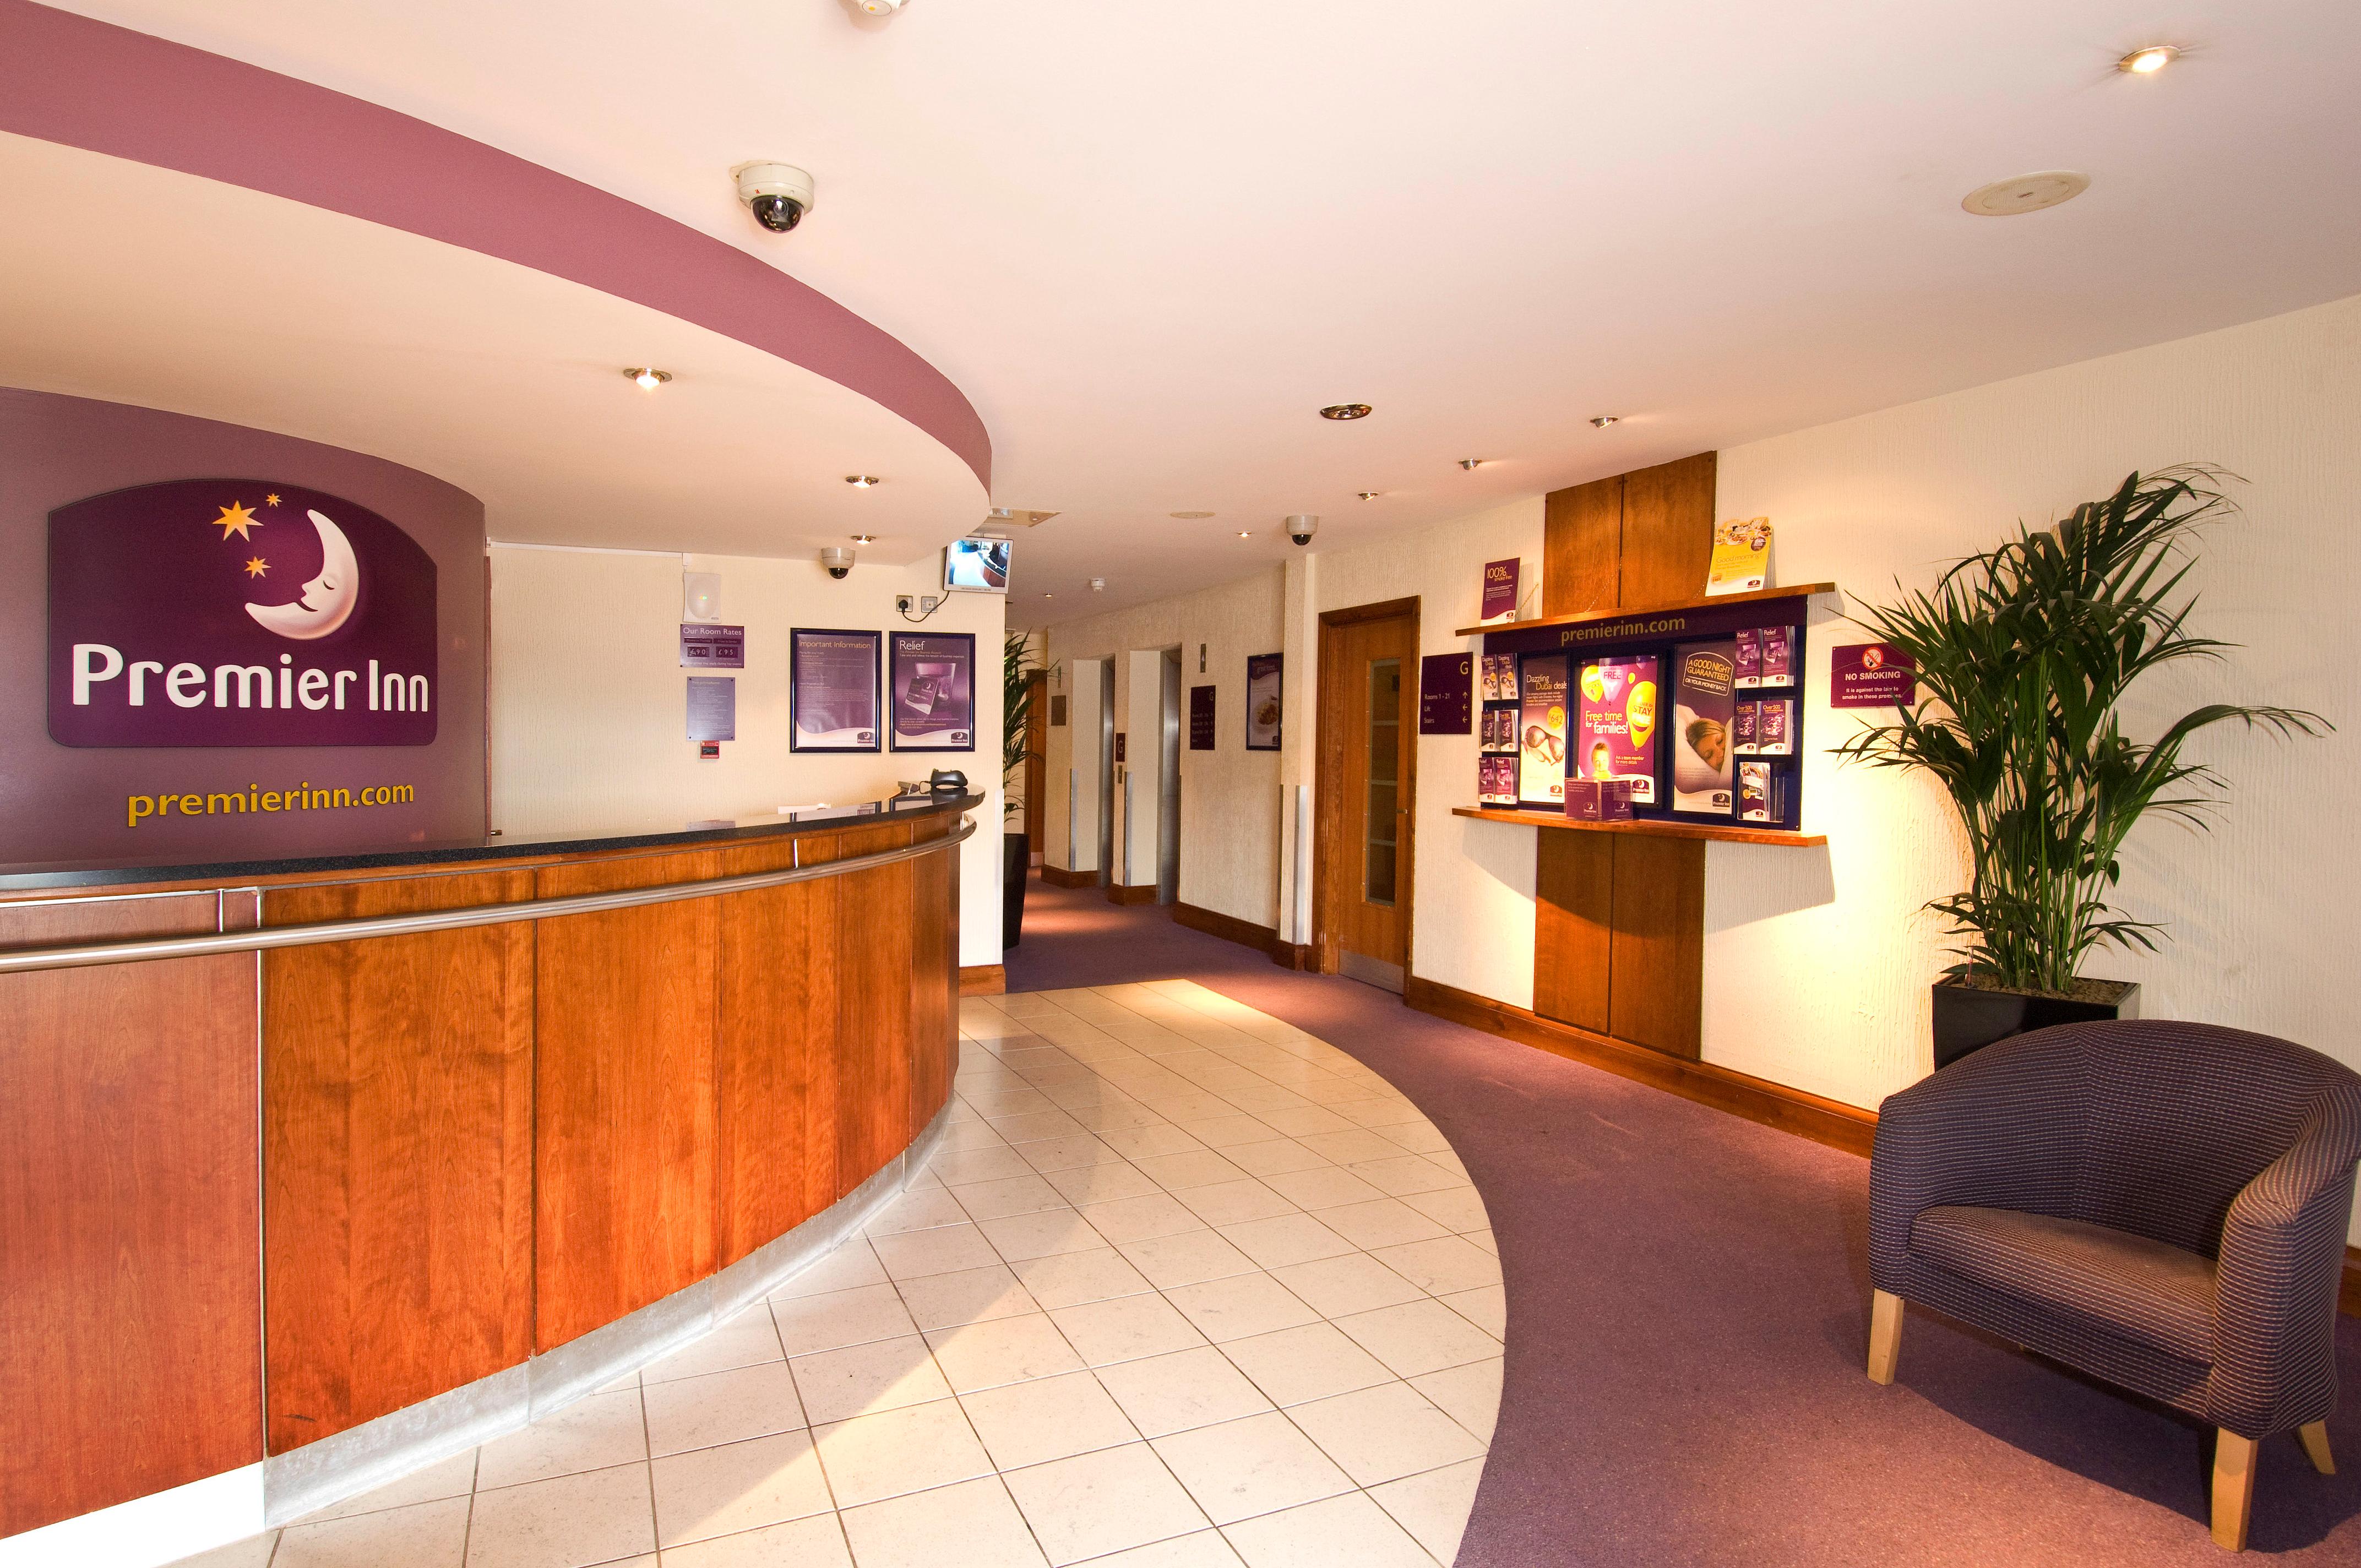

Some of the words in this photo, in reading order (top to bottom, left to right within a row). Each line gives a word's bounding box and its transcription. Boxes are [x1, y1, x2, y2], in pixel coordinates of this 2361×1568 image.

[1487, 565, 1507, 579] 100%
[1561, 618, 1685, 646] premierinn.com
[799, 640, 833, 649] Important
[900, 640, 925, 650] Relief
[1460, 661, 1468, 674] G
[1693, 659, 1712, 670] GOOD
[1712, 662, 1731, 674] NIGHT
[72, 643, 357, 711] Premier
[368, 659, 429, 712] Inn
[1526, 674, 1549, 683] Dazzling
[1687, 666, 1729, 682] GUARANTEED
[1859, 671, 1901, 680] SMOKING
[1536, 682, 1552, 690] Dubai
[1553, 680, 1567, 689] deals
[1586, 710, 1603, 721] Free
[1604, 710, 1623, 721] time
[1633, 705, 1652, 716] STAY
[1593, 721, 1629, 734] families!
[1118, 740, 1123, 754] G
[127, 781, 415, 827] premierinn.com
